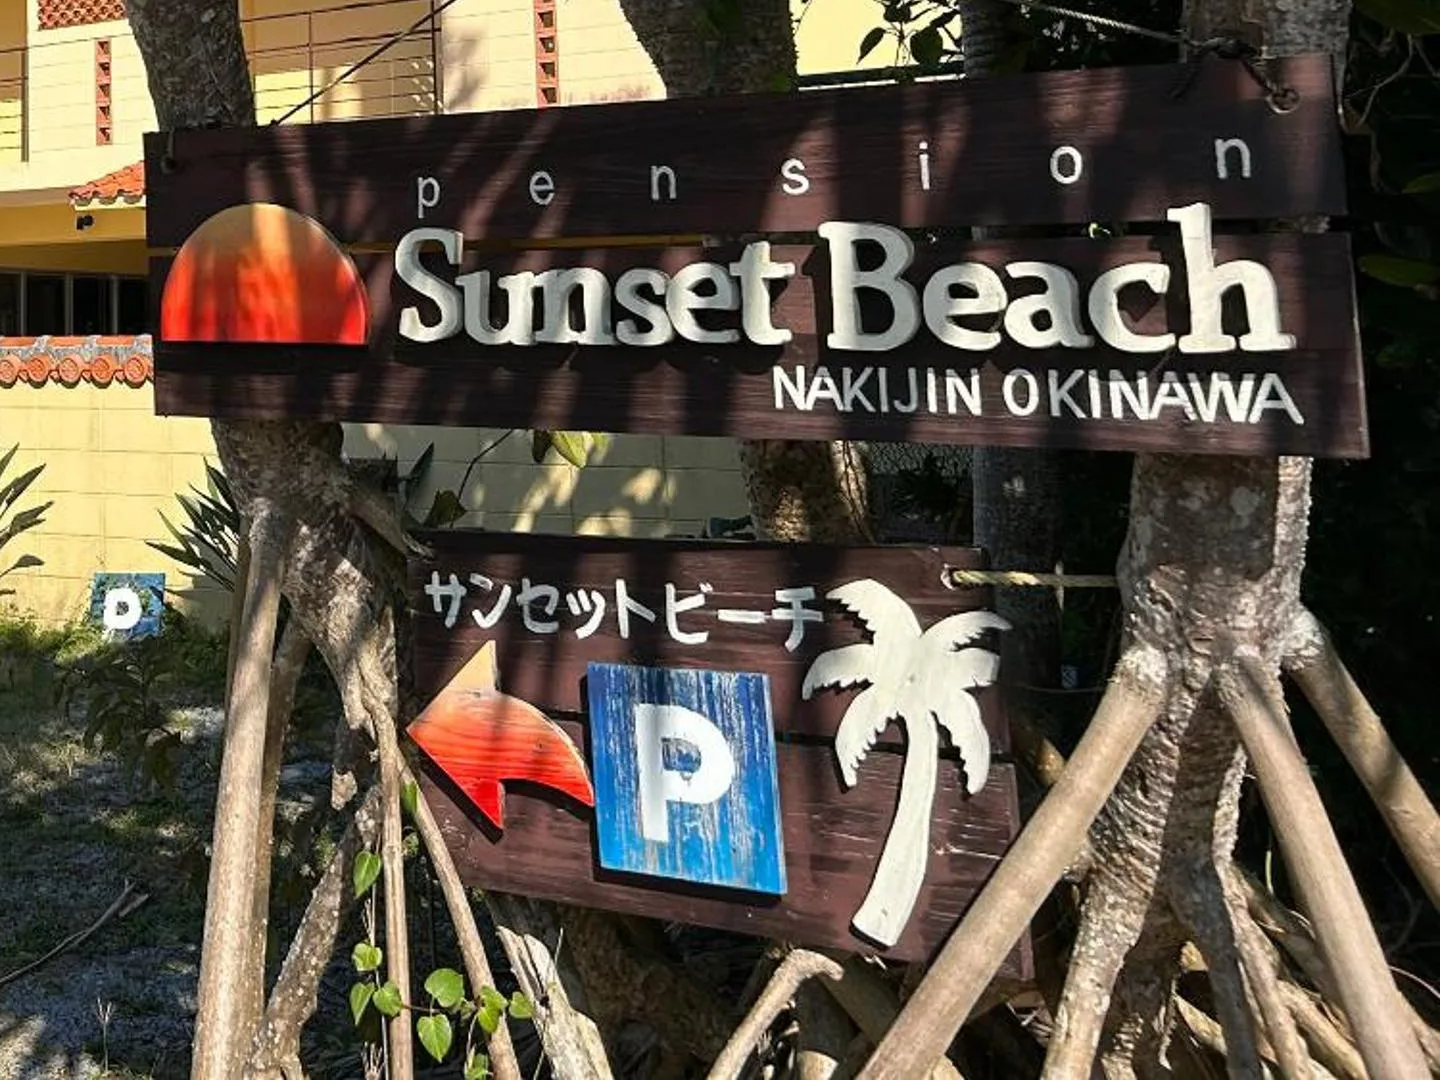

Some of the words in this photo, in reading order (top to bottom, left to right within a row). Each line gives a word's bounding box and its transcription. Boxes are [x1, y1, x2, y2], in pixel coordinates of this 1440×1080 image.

[417, 136, 1251, 218] pension
[394, 227, 795, 347] Sunset
[817, 202, 1298, 353] Beach
[772, 365, 980, 417] NAKIJIN
[1001, 368, 1304, 426] OKINAWA
[424, 569, 824, 652] サンセットビーチ
[634, 702, 736, 843] P
